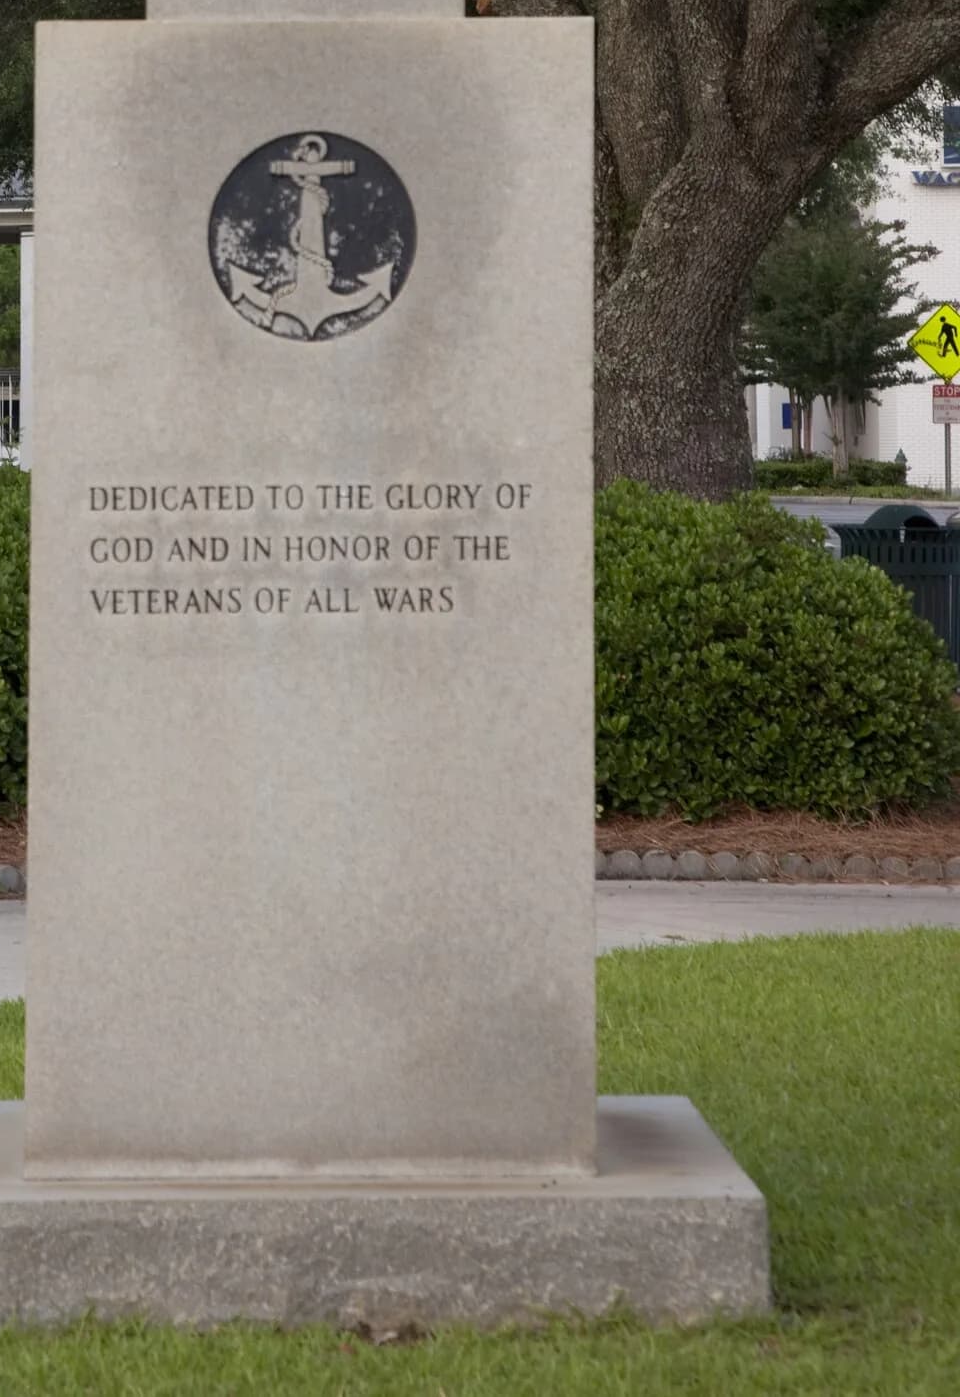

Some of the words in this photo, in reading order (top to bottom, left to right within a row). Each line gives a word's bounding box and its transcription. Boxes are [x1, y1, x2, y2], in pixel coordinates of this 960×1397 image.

[89, 485, 254, 511] DEDICATED
[265, 484, 304, 510] TO
[316, 484, 373, 510] THE
[385, 483, 483, 511] GLORY
[495, 483, 532, 510] OF
[89, 536, 154, 563] GOD
[167, 536, 230, 562] AND
[243, 536, 272, 562] IN
[284, 535, 390, 562] HONOR
[403, 534, 441, 561] OF
[452, 535, 511, 561] THE
[89, 587, 242, 614] VETERANS
[254, 587, 291, 613] OF
[304, 587, 360, 613] ALL
[373, 586, 454, 613] WARS
